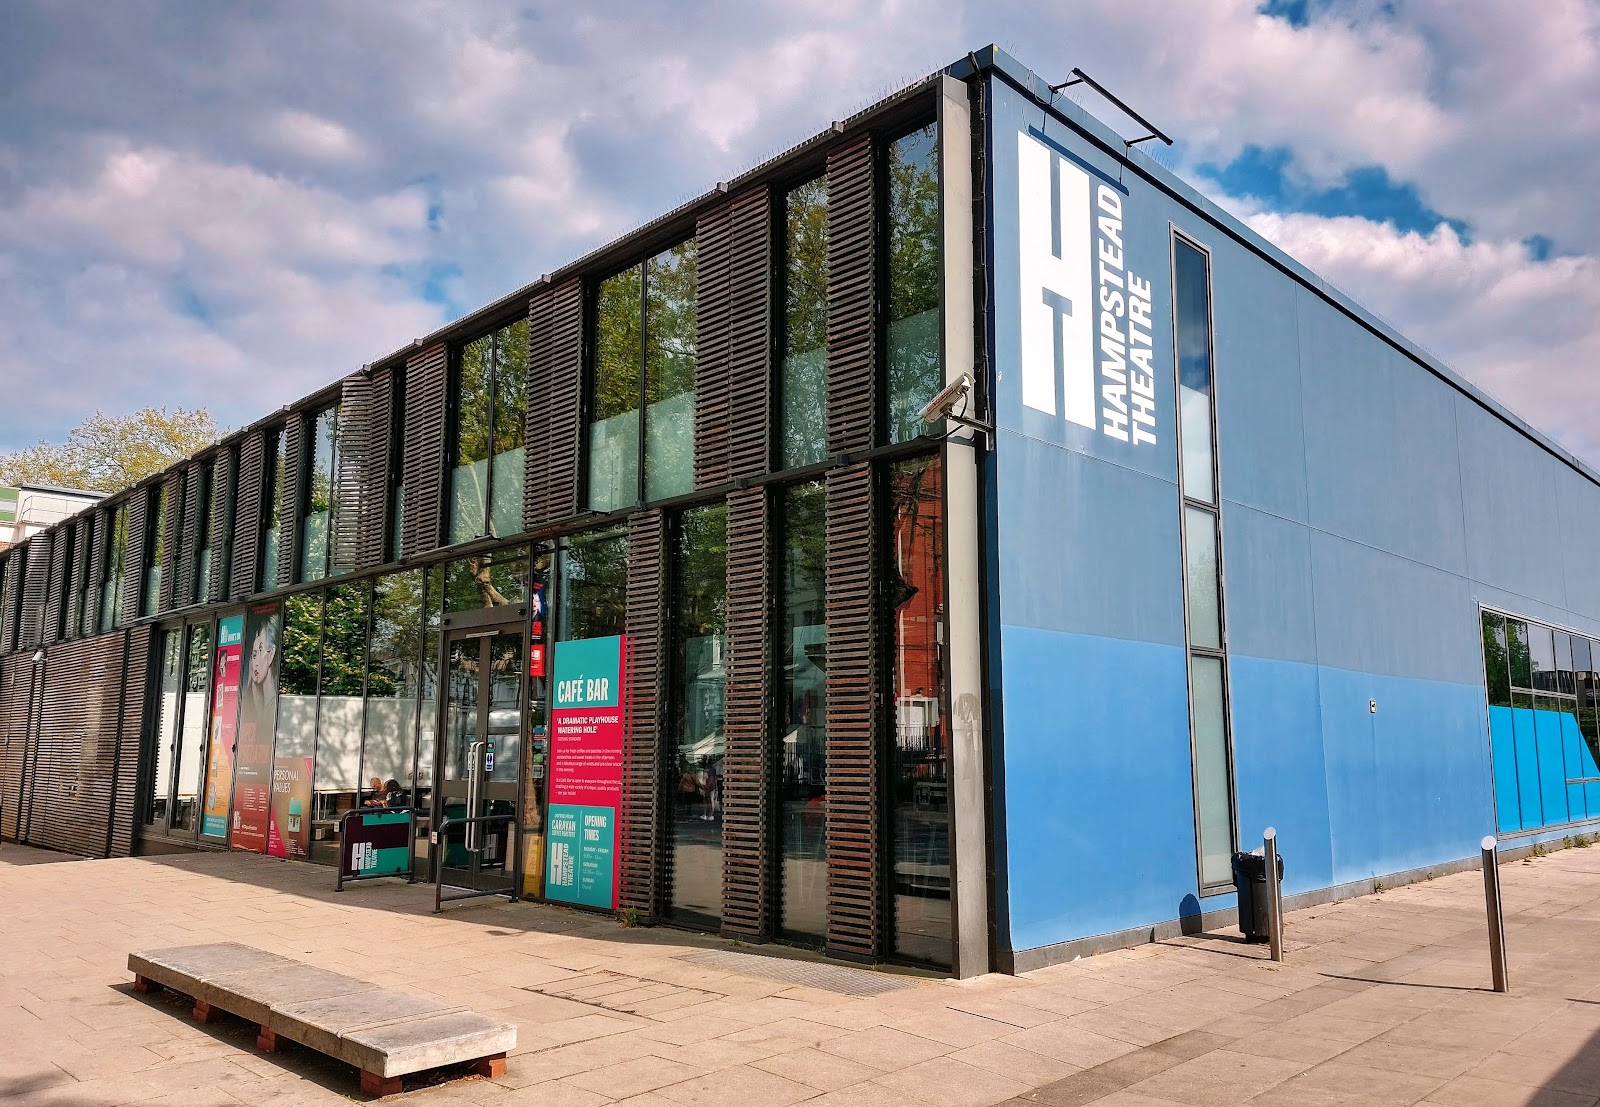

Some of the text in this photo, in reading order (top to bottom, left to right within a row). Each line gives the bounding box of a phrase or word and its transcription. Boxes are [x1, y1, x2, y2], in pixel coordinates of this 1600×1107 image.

[1098, 184, 1128, 442] HAMPSTEAD
[1127, 270, 1157, 446] THEATRE
[558, 674, 608, 703] CAFÉ BAR
[589, 716, 618, 724] PLAYHOUSE
[558, 726, 582, 734] WATERING
[274, 770, 299, 781] PERSONAL
[273, 782, 290, 793] VALUES
[552, 820, 575, 831] CARAVAN
[584, 815, 606, 827] OPENING
[584, 829, 599, 841] TIMES
